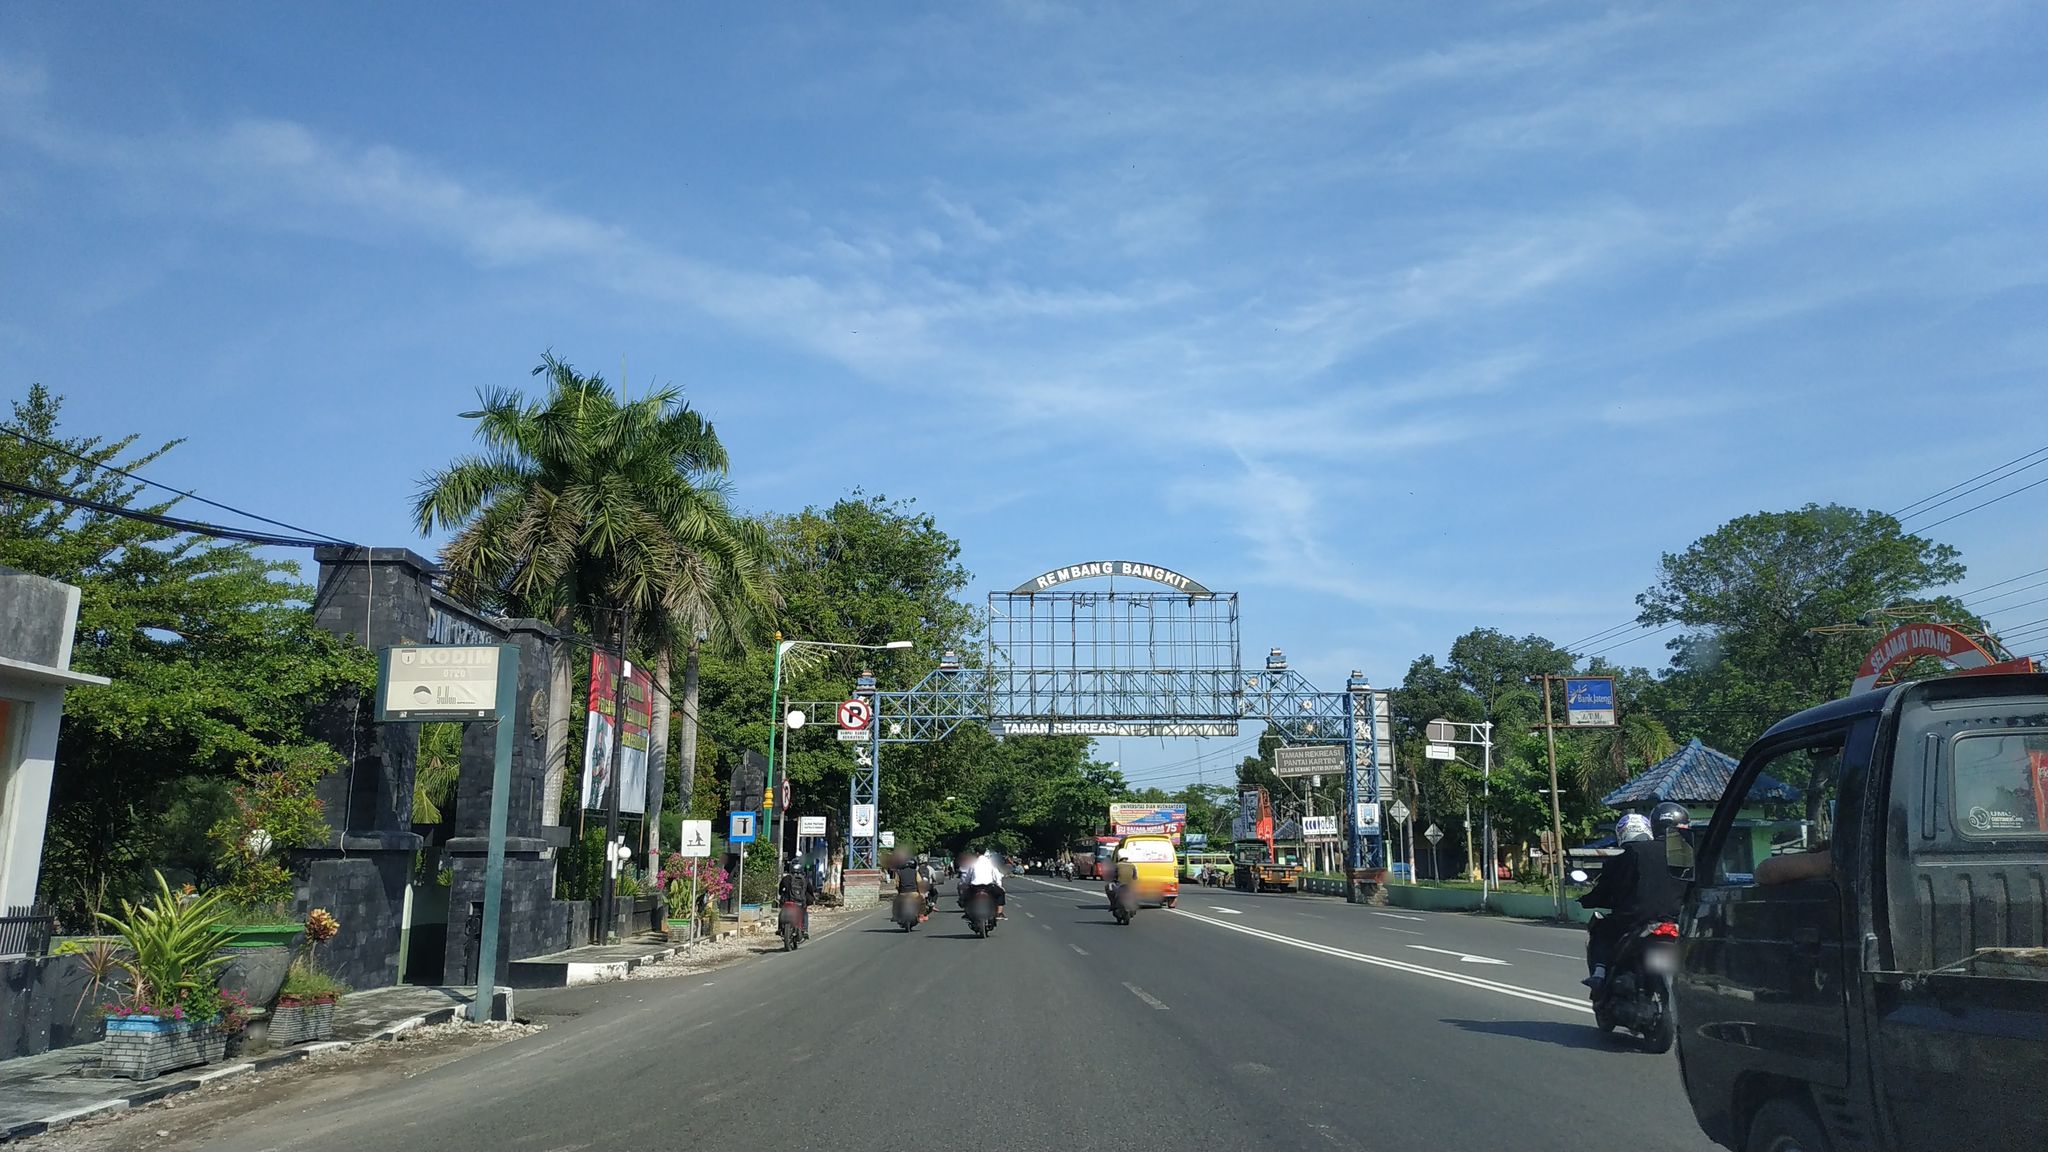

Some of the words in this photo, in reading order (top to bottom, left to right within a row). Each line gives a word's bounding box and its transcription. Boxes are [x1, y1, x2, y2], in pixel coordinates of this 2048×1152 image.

[1036, 561, 1113, 589] REMBANG
[1122, 562, 1191, 589] BANGKIT
[1870, 632, 1908, 673] SELAMAT
[1911, 628, 1951, 653] DATANG
[421, 650, 492, 664] KODIM
[1577, 693, 1593, 703] Bank
[1593, 693, 1612, 705] Jateng
[1003, 723, 1049, 734] TAMAN
[1305, 750, 1341, 758] REKREASI
[1165, 824, 1178, 833] 75
[1317, 819, 1337, 830] OLISI
